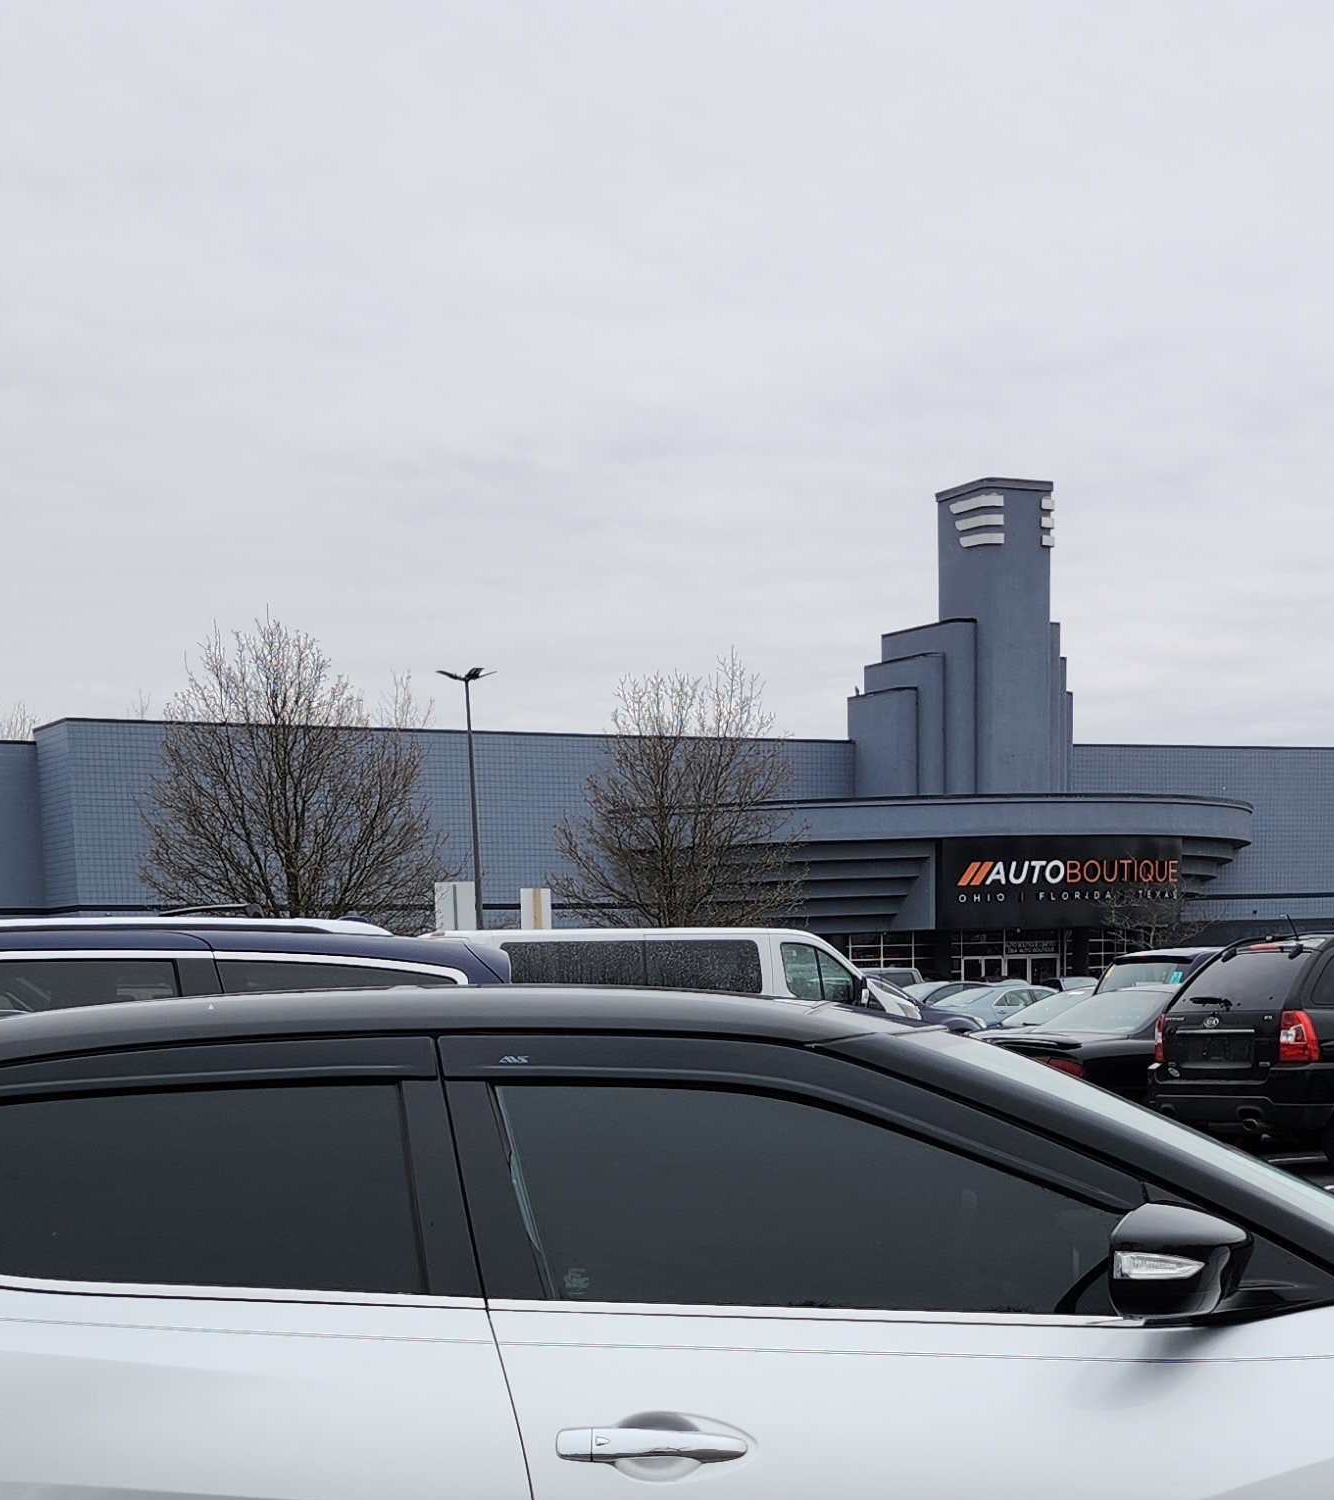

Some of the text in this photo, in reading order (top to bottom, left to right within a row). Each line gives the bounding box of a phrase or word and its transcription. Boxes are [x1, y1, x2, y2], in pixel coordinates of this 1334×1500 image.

[958, 890, 1177, 903] OHIO FLORIDA TEXAS
